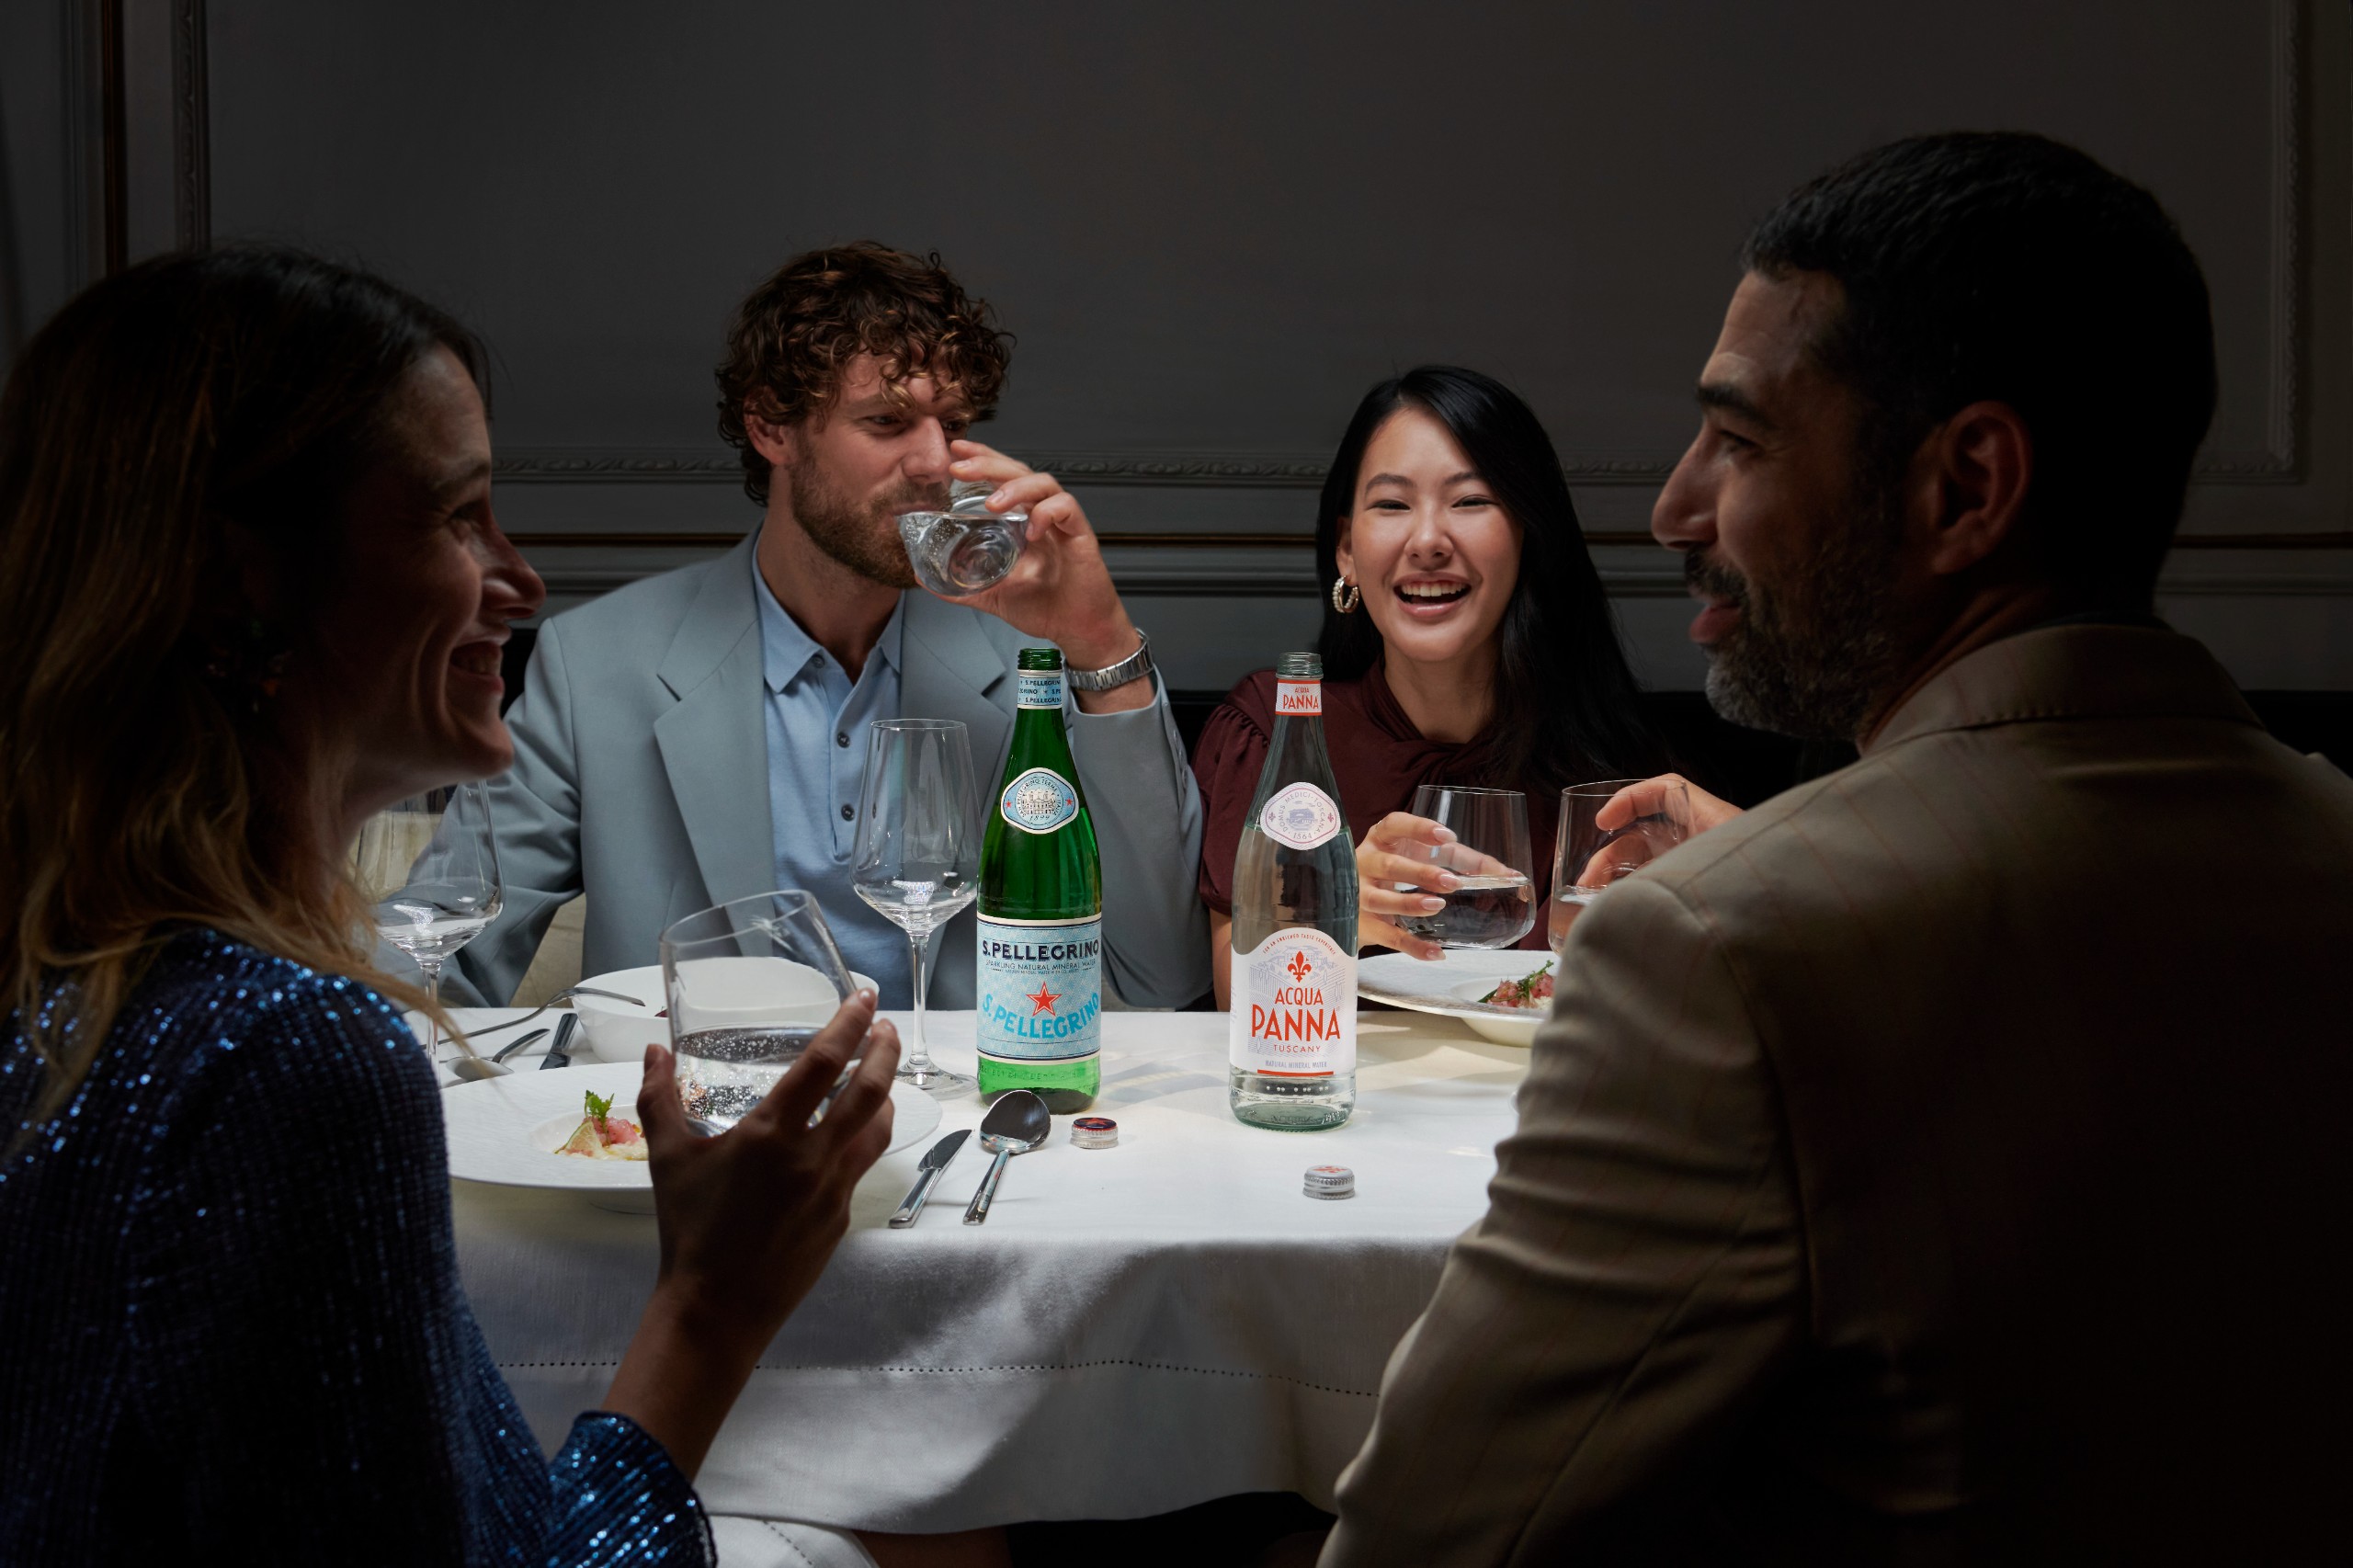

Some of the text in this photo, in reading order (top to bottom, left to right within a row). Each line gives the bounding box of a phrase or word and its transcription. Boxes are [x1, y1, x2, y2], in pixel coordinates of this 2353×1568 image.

[1282, 694, 1319, 710] PANNA
[1278, 805, 1289, 832] DOMUS
[983, 938, 1099, 961] S.PELLEGRINO
[985, 959, 1016, 970] SPARKLING
[1017, 962, 1050, 971] NATURAL
[1275, 987, 1324, 1006] ACQUA
[983, 993, 1099, 1039] S.PELLEGRINO
[1251, 1004, 1341, 1041] PANNA
[1274, 1044, 1321, 1052] TUSCANY
[1265, 1060, 1287, 1068] NATURAL
